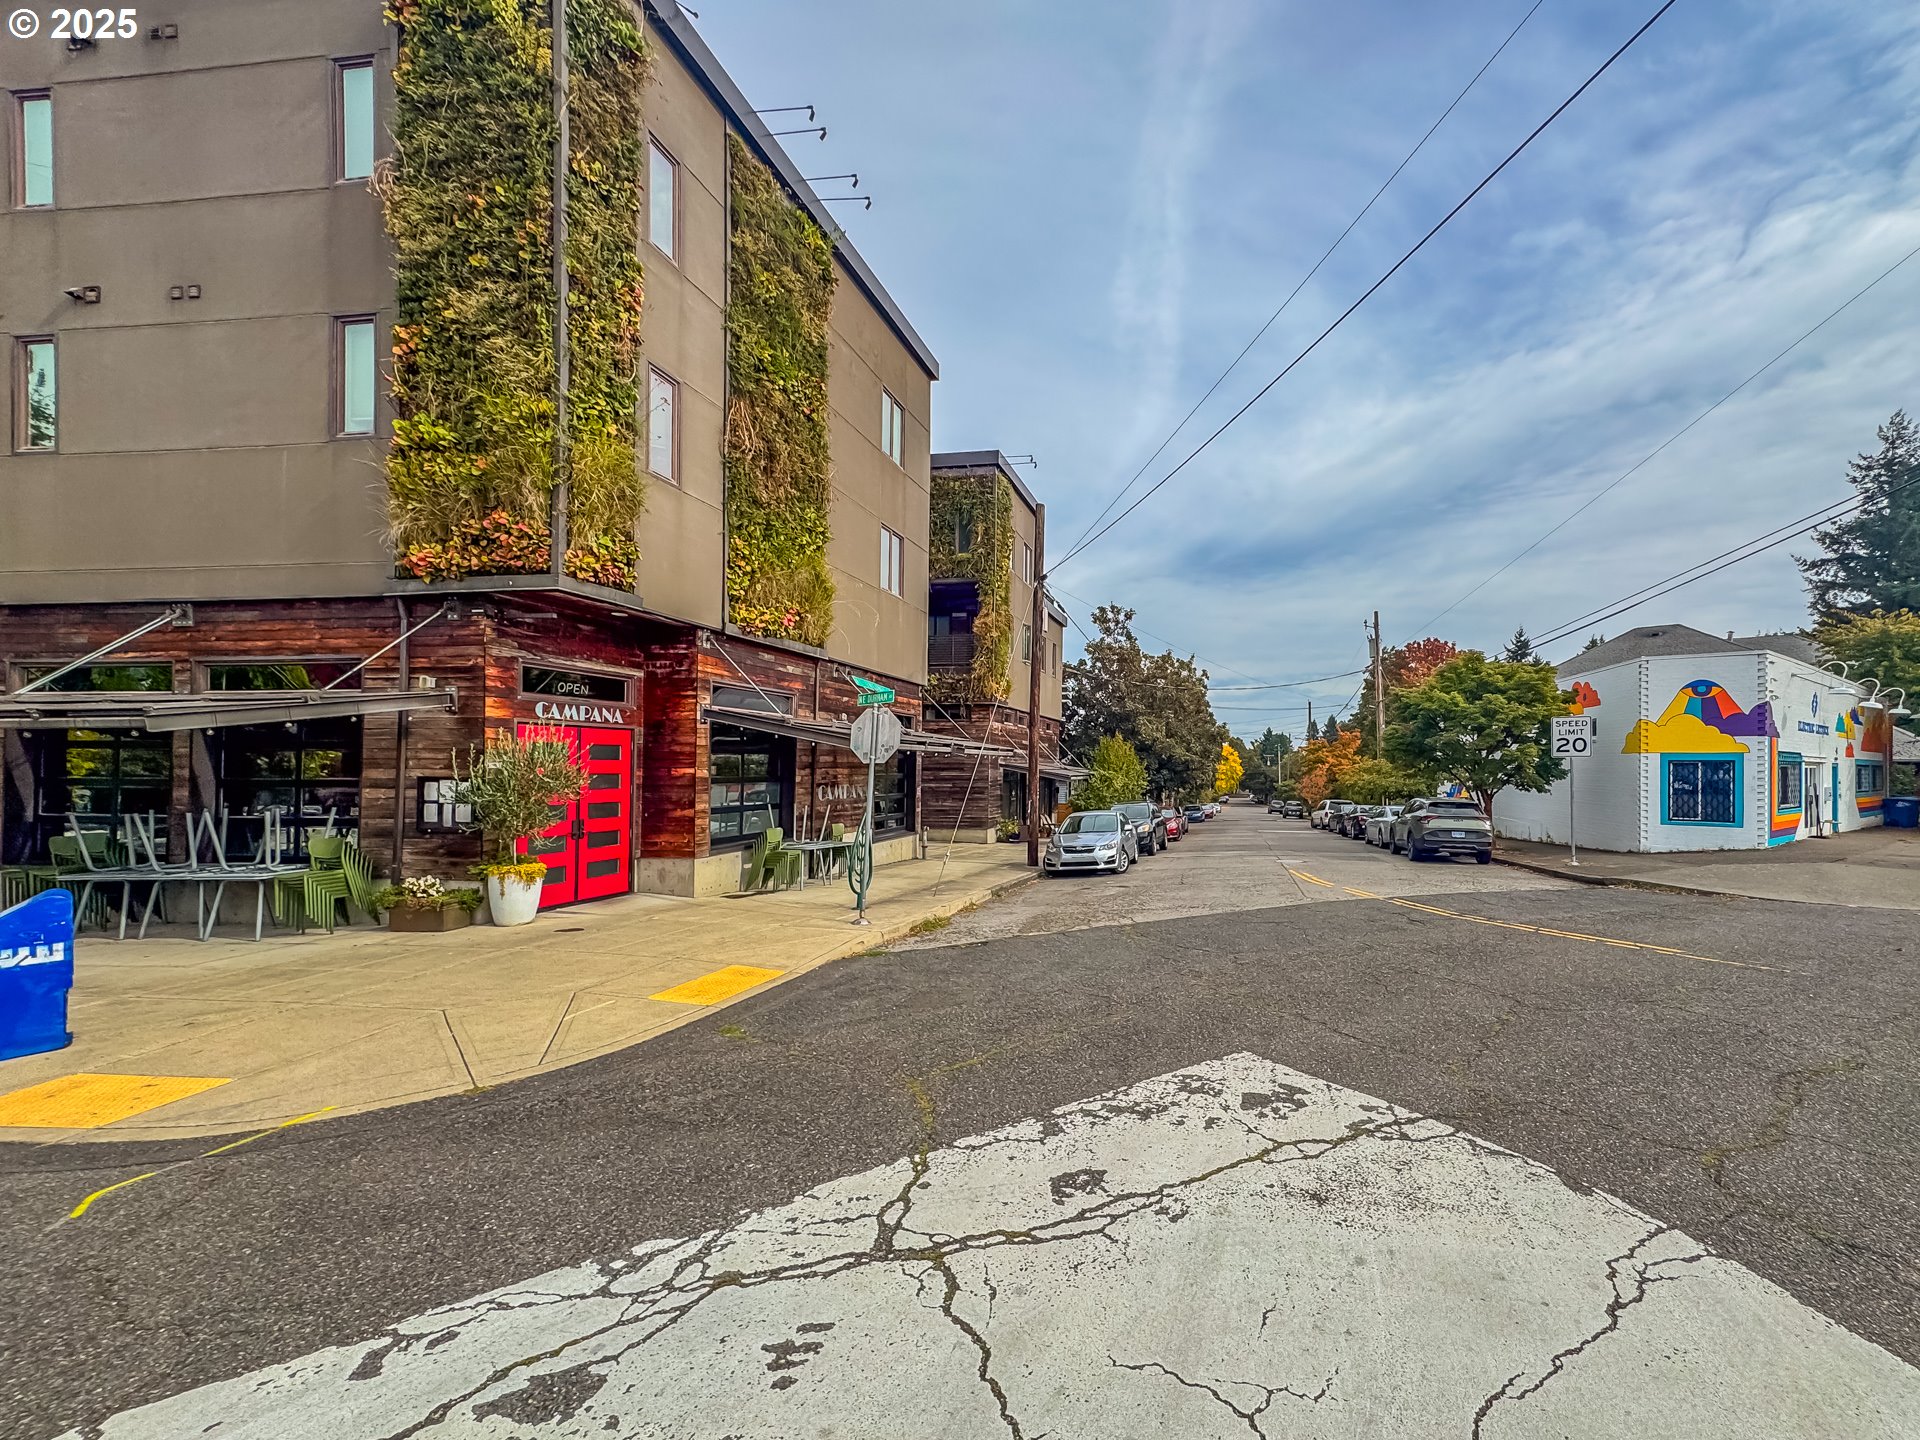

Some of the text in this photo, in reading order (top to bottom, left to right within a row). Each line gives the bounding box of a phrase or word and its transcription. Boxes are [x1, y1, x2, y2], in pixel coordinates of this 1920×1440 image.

[557, 682, 589, 695] OPEN
[859, 696, 866, 704] NE
[867, 693, 888, 703] DURHAM
[535, 701, 624, 724] CAMPANA
[1555, 720, 1588, 728] SPEED
[1556, 738, 1588, 753] 20
[818, 785, 865, 801] CAMPAN
